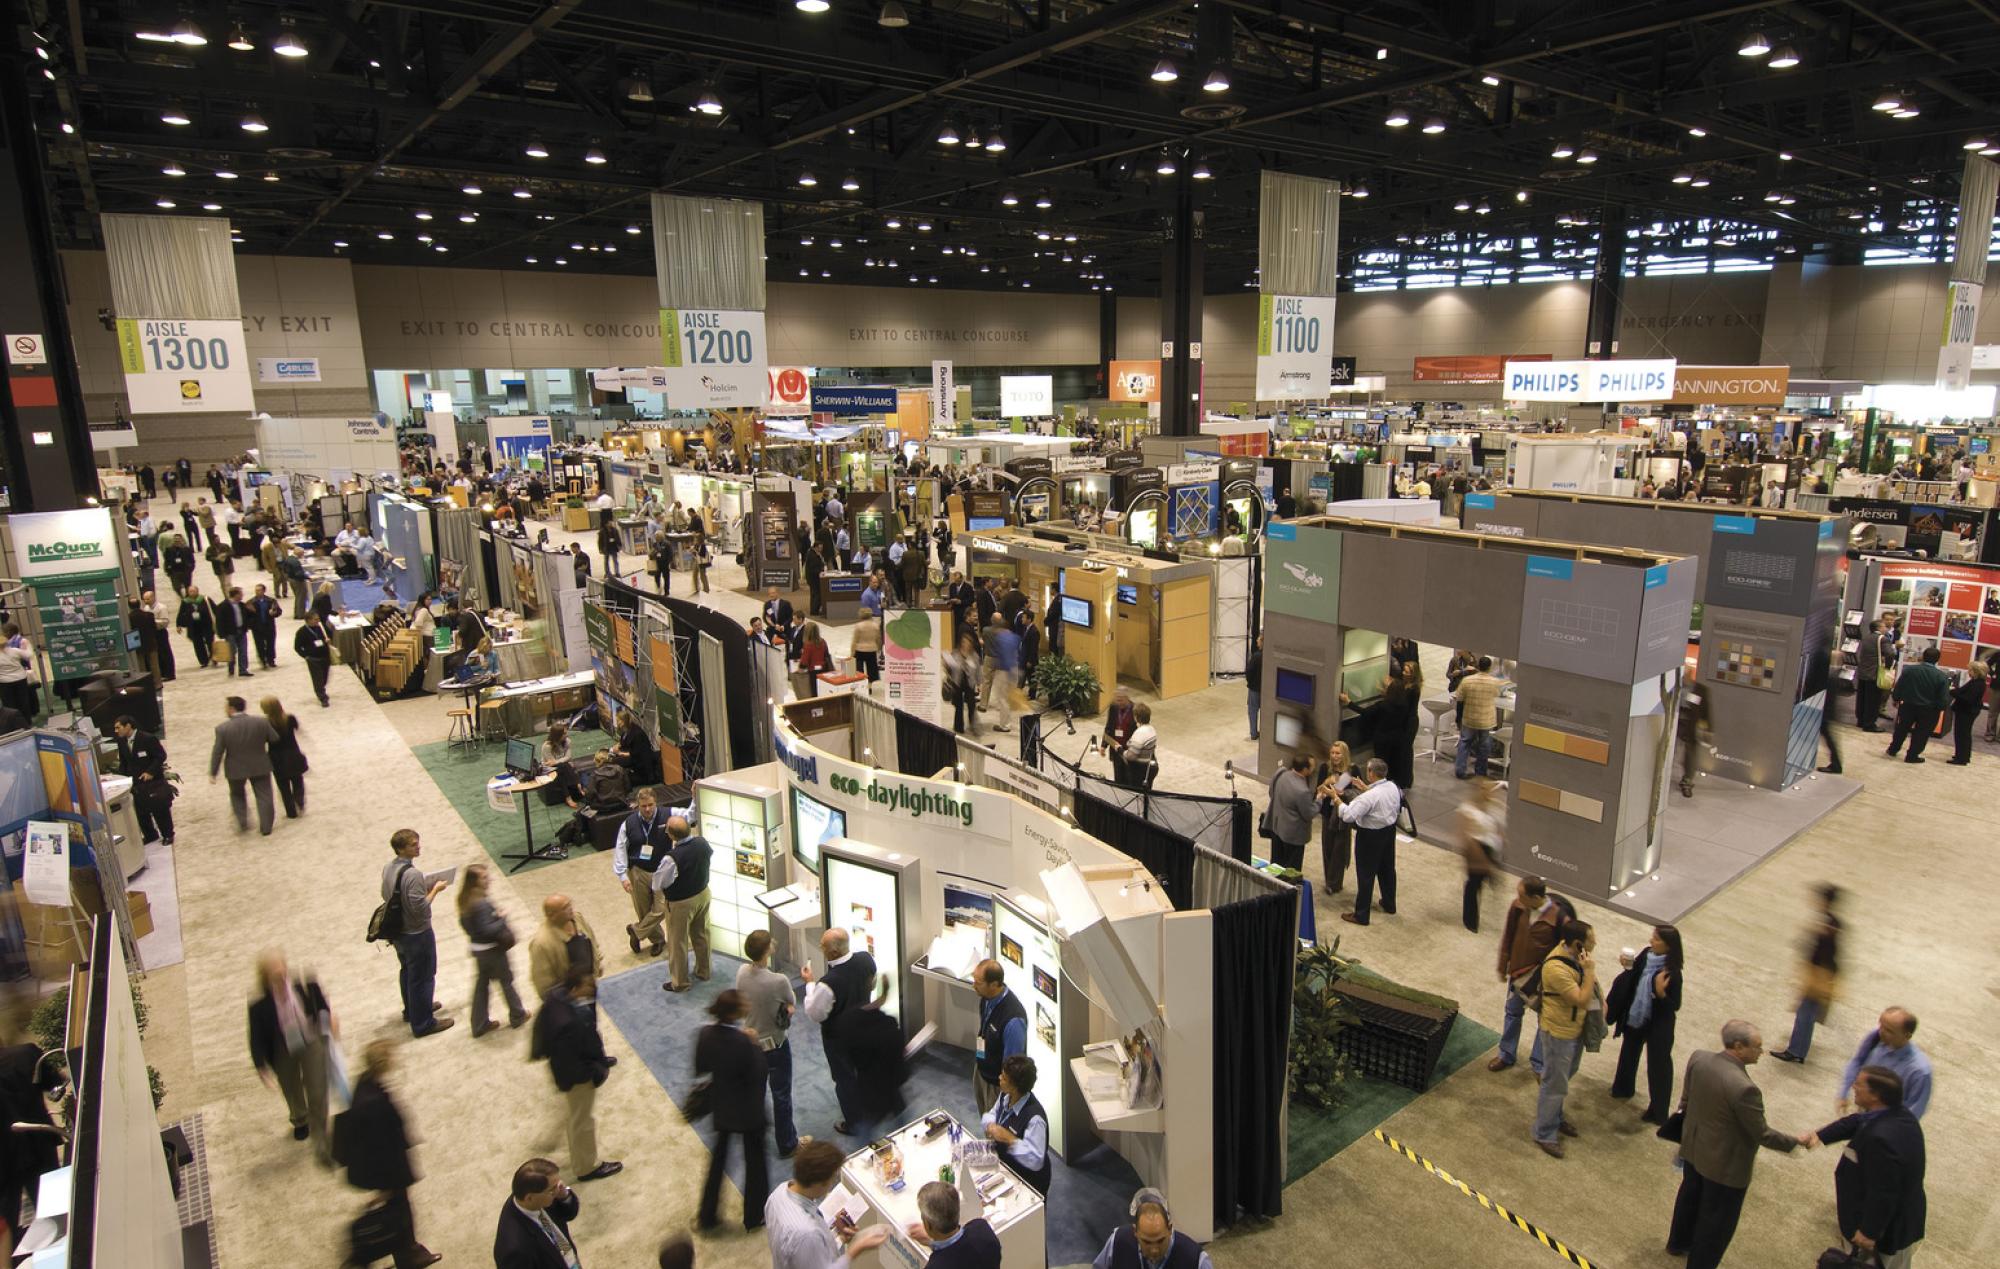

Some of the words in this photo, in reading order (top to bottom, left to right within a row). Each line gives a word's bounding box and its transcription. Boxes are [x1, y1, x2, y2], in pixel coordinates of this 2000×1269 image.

[1276, 299, 1303, 315] AISLE
[280, 316, 332, 333] EXIT
[683, 313, 720, 328] AISLE
[1723, 314, 1763, 328] EXIT
[145, 322, 189, 337] AISLE
[401, 321, 446, 336] EXIT
[456, 321, 480, 336] TO
[489, 322, 575, 337] CENTRAL
[850, 328, 878, 341] EXIT
[884, 328, 898, 341] TO
[904, 329, 957, 342] CENTRAL
[963, 329, 1030, 343] CONCOURSE
[1275, 316, 1320, 354] 1100
[147, 337, 230, 371] 1300
[684, 329, 753, 364] 1200
[1280, 369, 1312, 381] Armstrong
[1511, 373, 1580, 393] PHILIPS
[1599, 371, 1666, 392] PHILIPS
[709, 383, 738, 393] Holcim
[939, 366, 949, 418] Armstrong
[1010, 391, 1045, 402] TOTO
[347, 419, 374, 428] Johnson
[352, 427, 380, 436] Controls
[1840, 507, 1898, 521] Andersen
[28, 542, 101, 556] McQuay
[1884, 566, 1918, 575] Sustainable
[1919, 567, 1944, 577] building
[829, 772, 974, 826] eco-daylighting
